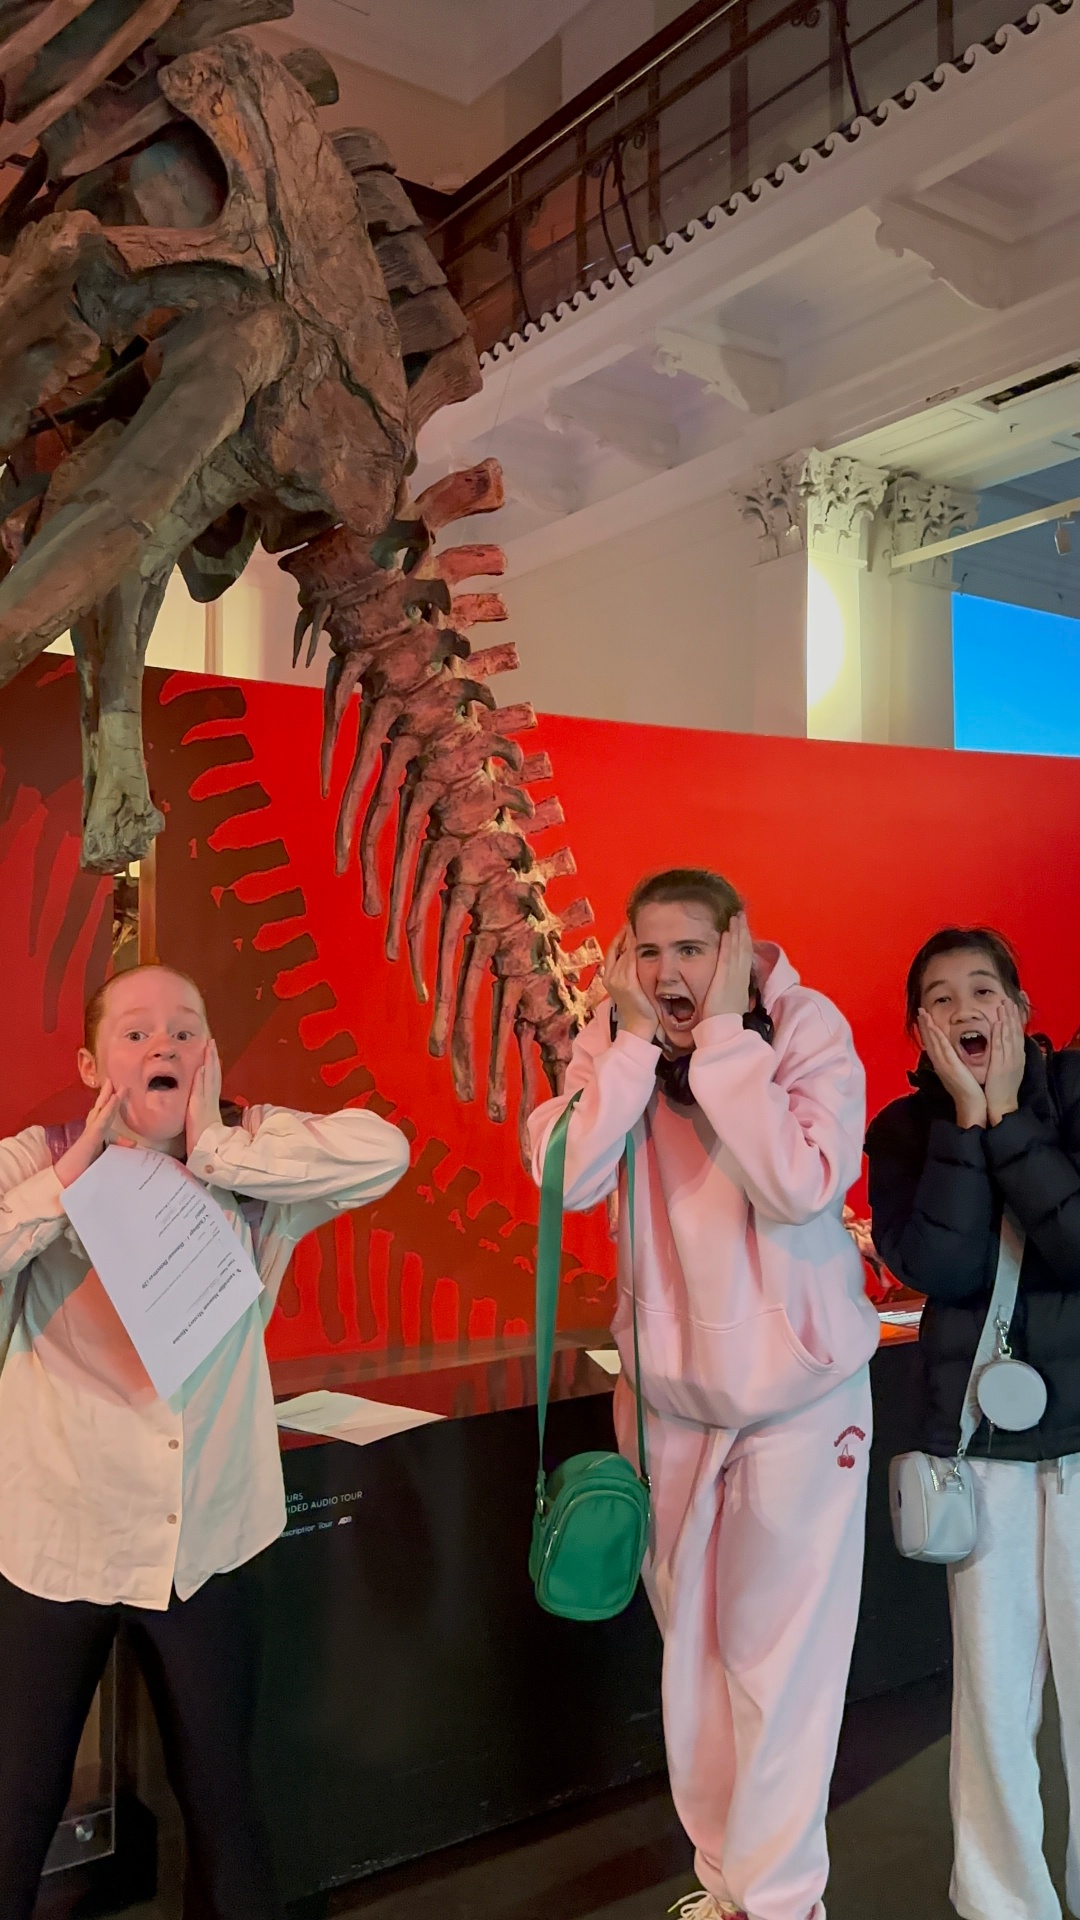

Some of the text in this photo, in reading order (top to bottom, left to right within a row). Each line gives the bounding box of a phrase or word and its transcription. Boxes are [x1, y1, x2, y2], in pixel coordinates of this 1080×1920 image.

[286, 1493, 303, 1502] URS
[286, 1491, 363, 1513] IDED AUDIO TOUR
[281, 1525, 315, 1537] escription
[317, 1521, 333, 1530] Tour
